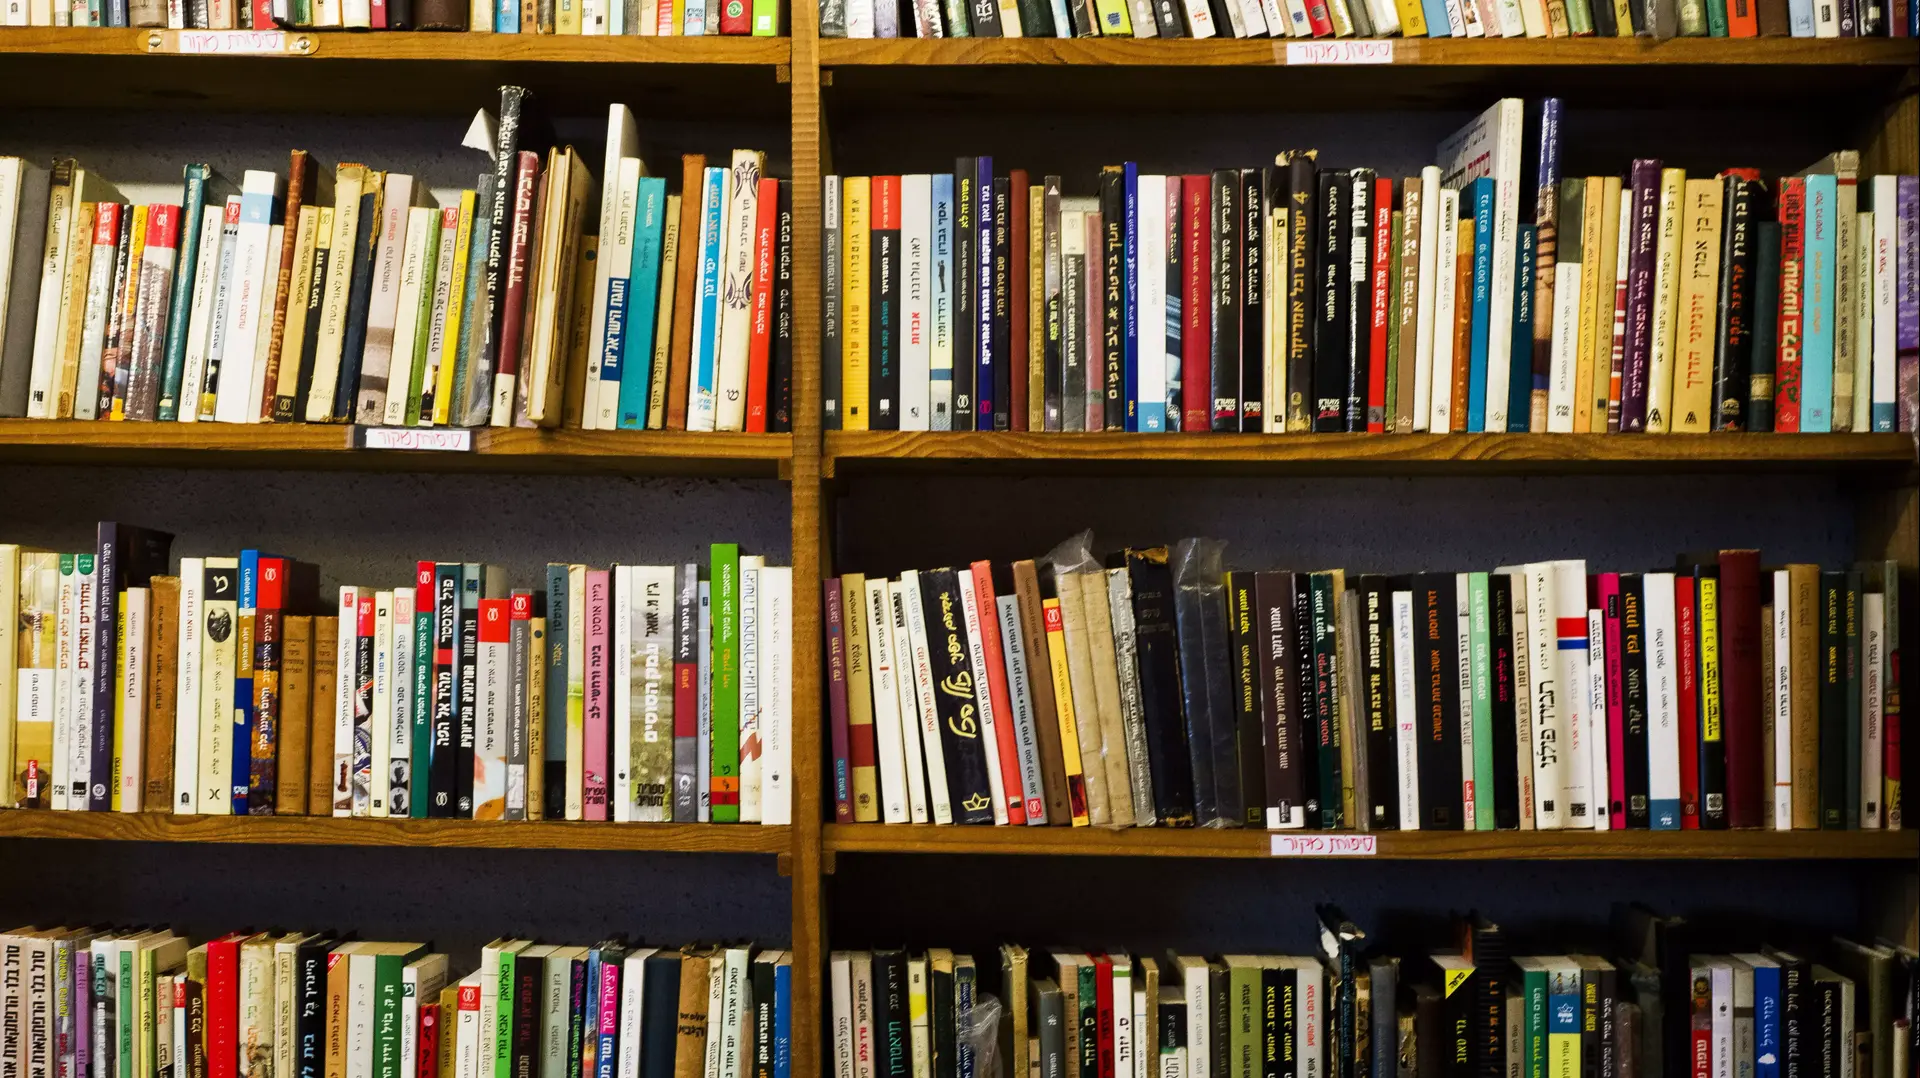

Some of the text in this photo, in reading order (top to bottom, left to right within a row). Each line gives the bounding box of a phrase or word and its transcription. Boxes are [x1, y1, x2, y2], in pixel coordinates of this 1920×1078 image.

[958, 178, 970, 228] פשוט זה לא
[780, 212, 791, 242] ערבים
[780, 246, 791, 280] רוקדים
[938, 201, 948, 348] אסף גברון הידרומניה
[1289, 192, 1308, 358] 4 ישראלים וכל אמריקה
[910, 238, 920, 344] לאה גולדברג אבדות
[682, 588, 690, 606] הנס
[1368, 592, 1380, 620] נשים
[592, 606, 603, 636] אוסטן
[418, 632, 427, 658] אוסטר
[592, 644, 601, 667] בינה
[680, 634, 690, 658] אדלר
[1368, 624, 1381, 668] שקופות
[1460, 634, 1468, 652] דויד
[1516, 632, 1525, 651] דויד
[397, 652, 405, 677] אוסטר
[435, 578, 454, 746] פול אוסטר מהיד אל הפה
[1241, 668, 1251, 684] ללא
[1462, 657, 1471, 690] גרוסמן
[1518, 654, 1527, 688] גרוסמן
[1625, 592, 1643, 734] יהונתן גפן אשה יקרה
[396, 686, 405, 704] ספר
[1538, 680, 1555, 726] תמיד
[396, 706, 404, 744] האשליות
[2, 945, 20, 1059] סול בלו הרפתקאות
[30, 950, 48, 1064] סול בלו הרפתקאות
[1266, 986, 1276, 1019] אברהם
[1284, 985, 1293, 1018] אברהם
[758, 1002, 769, 1044] אומברטו
[1120, 1036, 1130, 1062] יזהר
[1266, 1033, 1276, 1062] יהושע
[1284, 1032, 1293, 1061] יהושע
